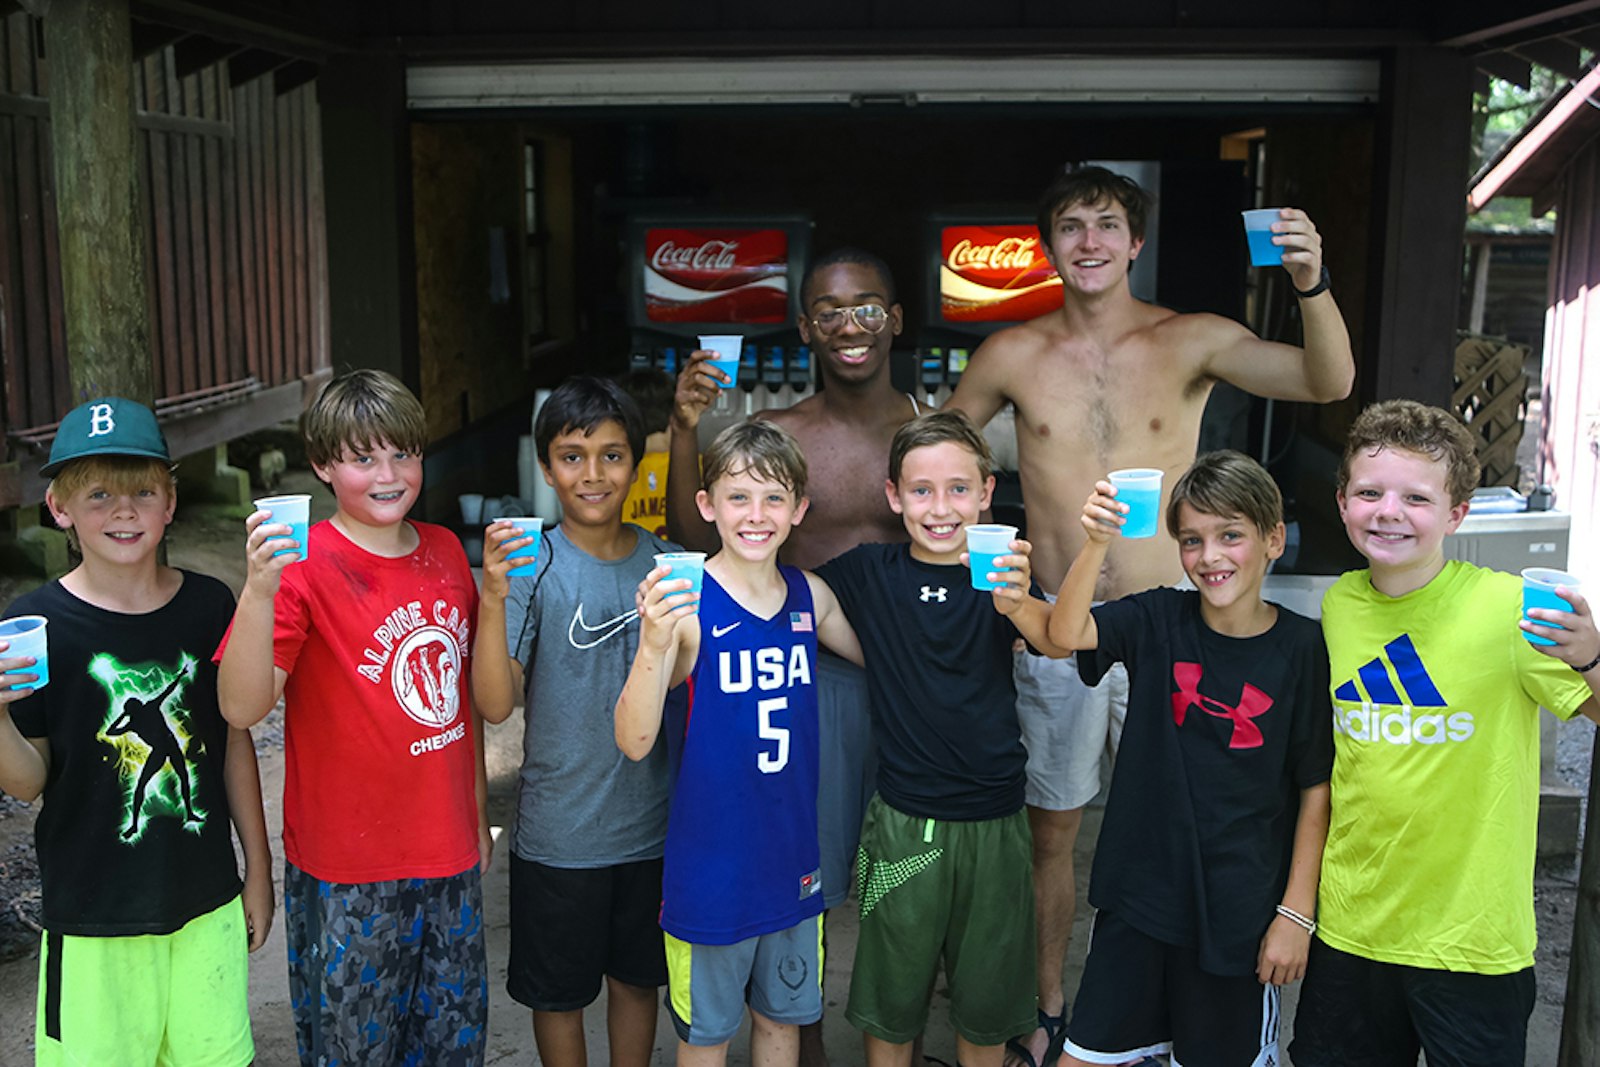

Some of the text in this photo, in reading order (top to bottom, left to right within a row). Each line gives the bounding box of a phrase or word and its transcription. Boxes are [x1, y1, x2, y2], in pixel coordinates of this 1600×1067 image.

[88, 403, 115, 438] B
[631, 497, 667, 519] JAME
[357, 601, 427, 684] ALPINE
[719, 644, 811, 693] USA
[757, 696, 790, 773] 5
